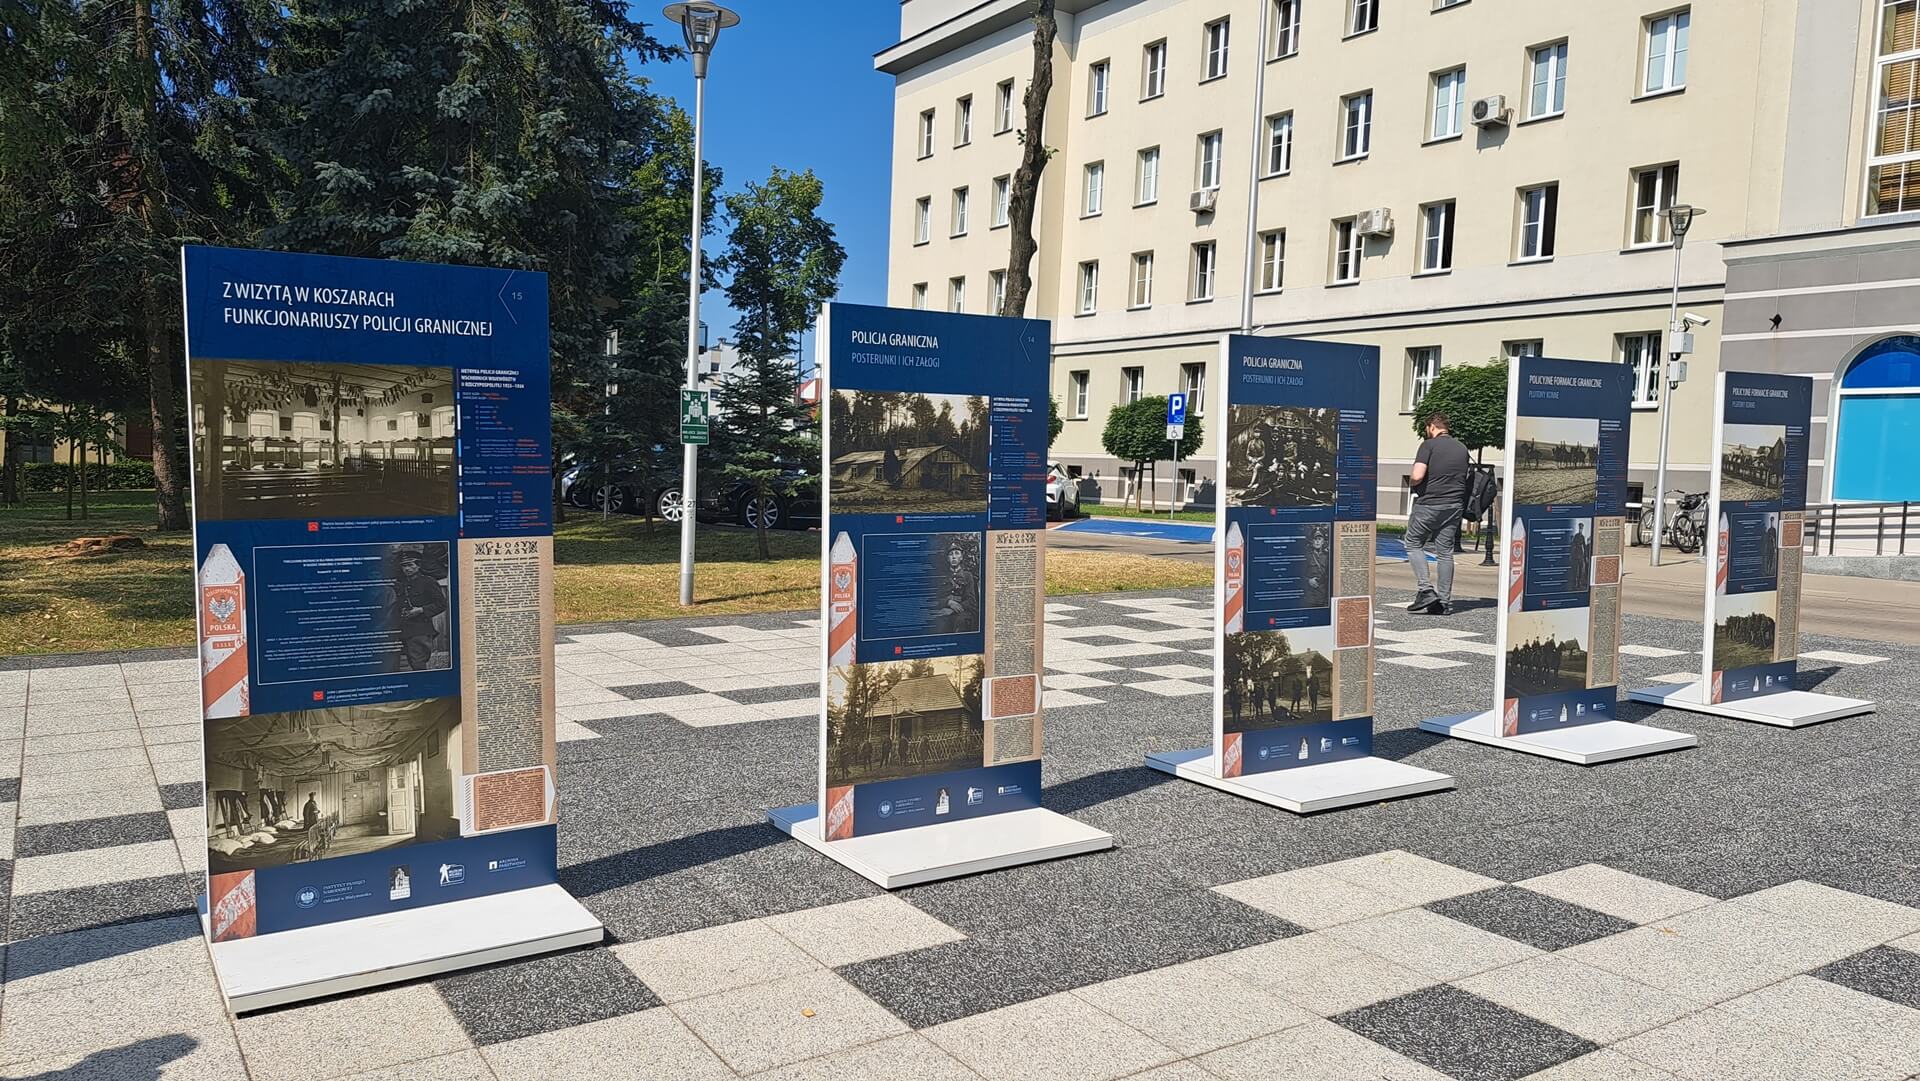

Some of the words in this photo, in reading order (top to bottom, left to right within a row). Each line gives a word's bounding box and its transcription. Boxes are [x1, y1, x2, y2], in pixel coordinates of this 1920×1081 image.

[223, 282, 232, 299] Z
[234, 283, 292, 305] WIZYTĄ
[294, 286, 311, 302] W
[313, 287, 395, 307] KOSZARACH
[511, 292, 523, 300] 15
[224, 308, 359, 330] FUNKCJONARIUSZY
[363, 315, 411, 333] POLICJI
[414, 320, 493, 337] GRANICZNEJ
[851, 330, 887, 345] POLICJA
[889, 333, 939, 349] GRANICZNA
[851, 352, 896, 366] POSTERUNKI
[902, 356, 914, 366] ICH
[915, 356, 940, 368] ZAŁOGI
[1243, 356, 1267, 368] POLICJA
[1268, 358, 1303, 370] GRANICZNA
[1172, 396, 1182, 415] P
[210, 624, 236, 632] POLSKA
